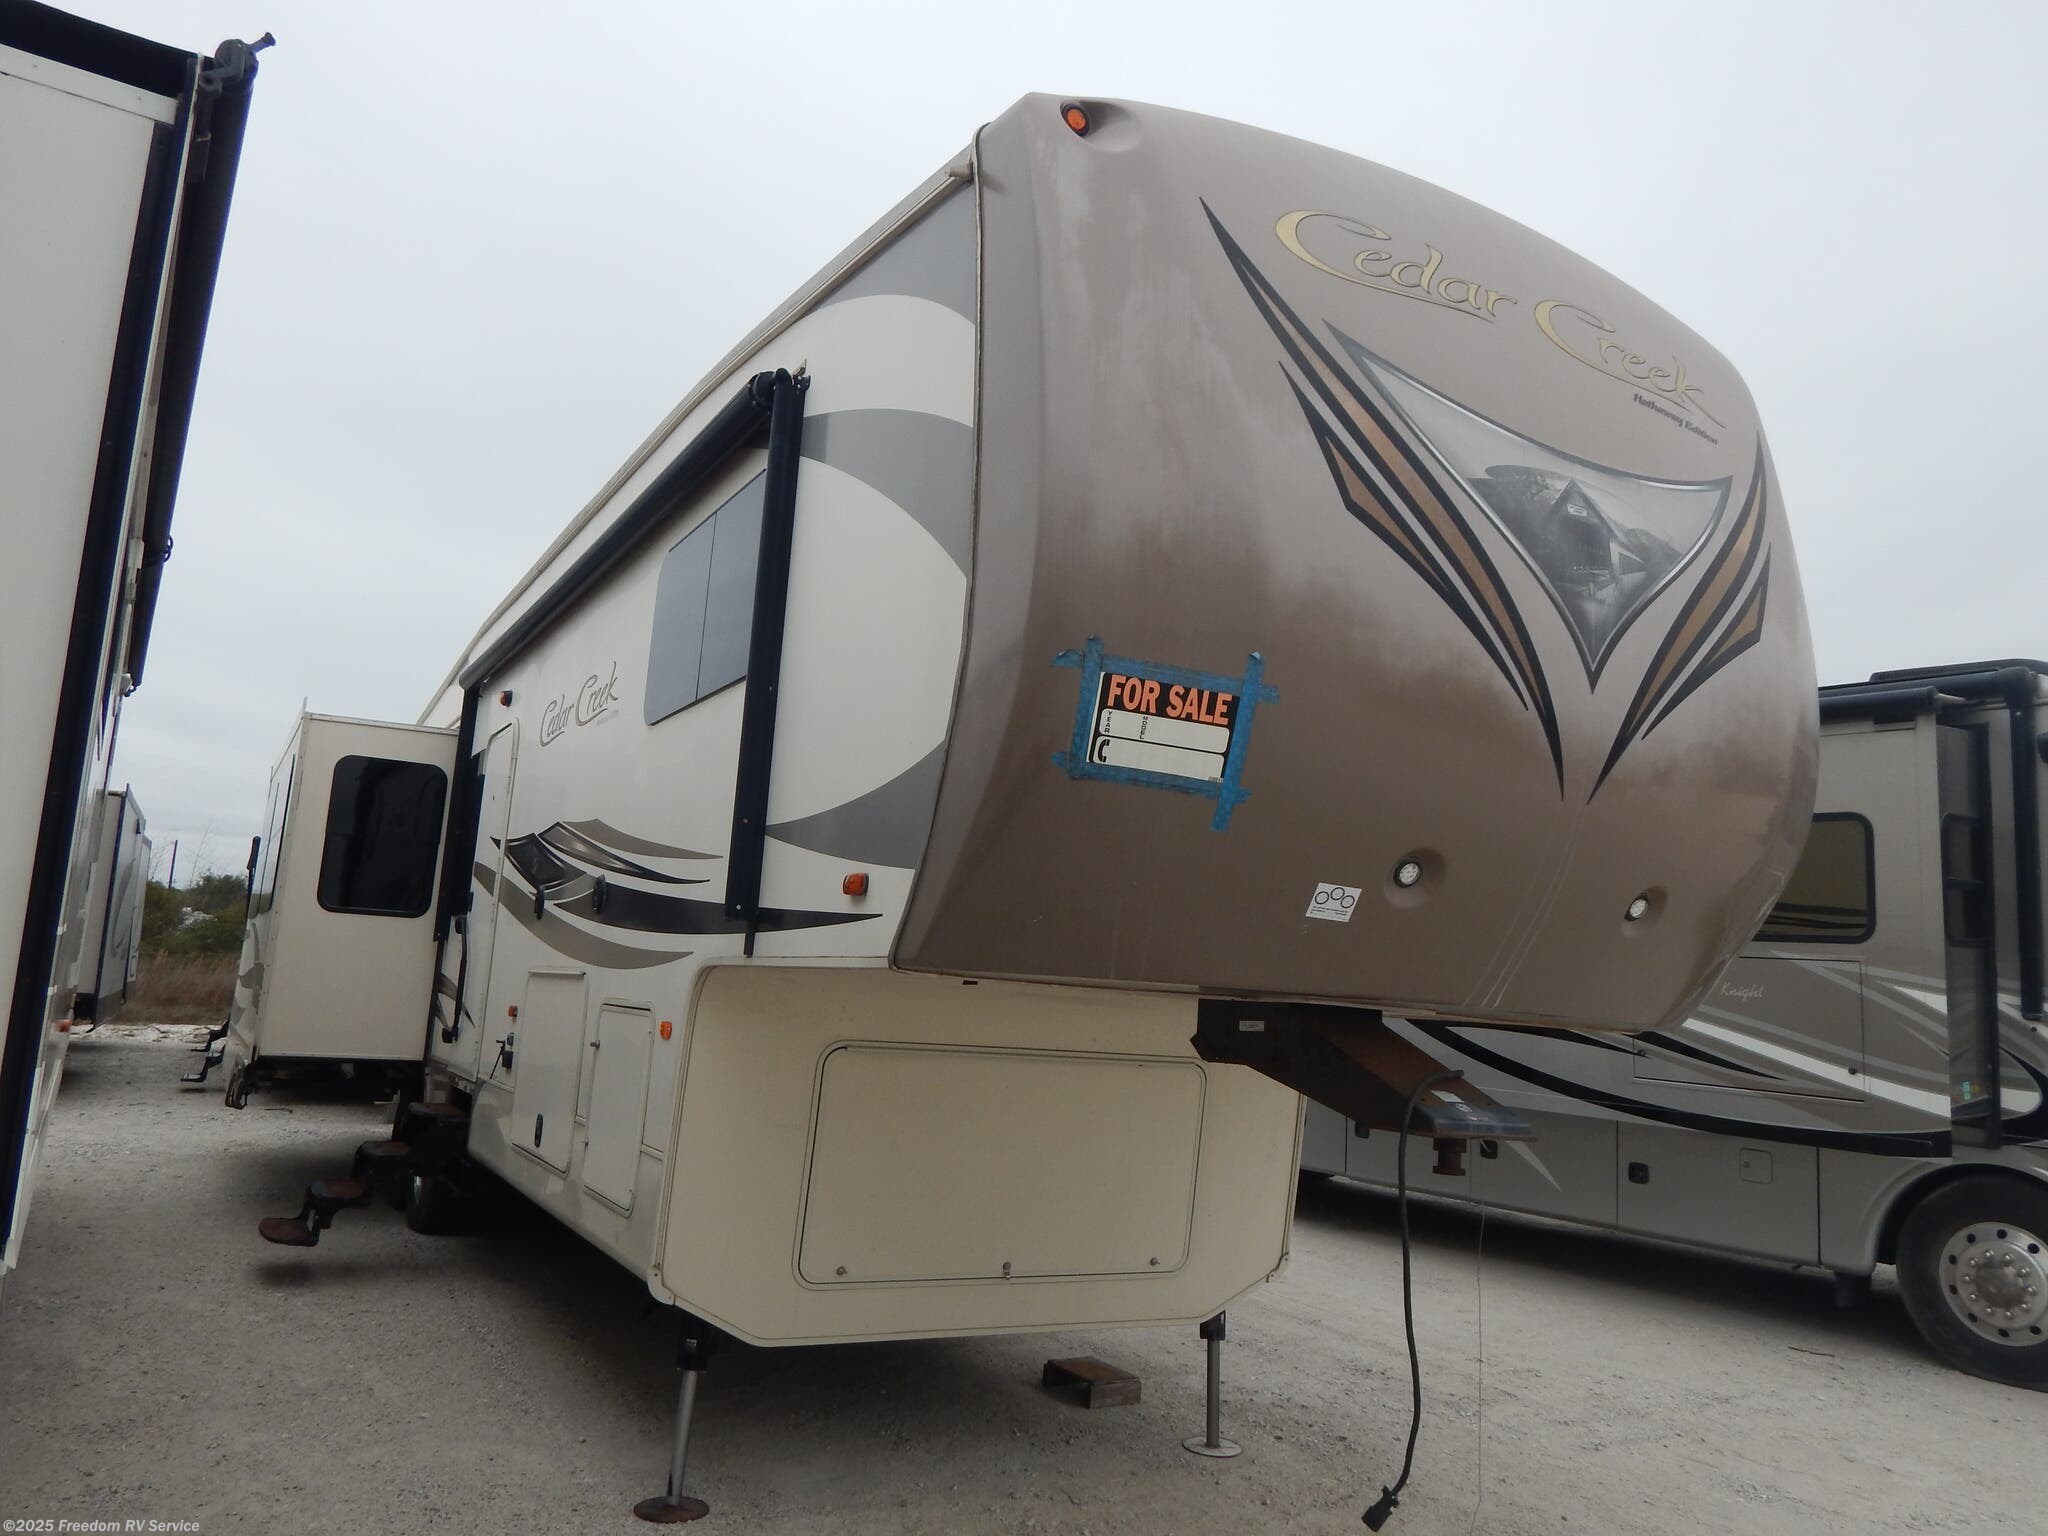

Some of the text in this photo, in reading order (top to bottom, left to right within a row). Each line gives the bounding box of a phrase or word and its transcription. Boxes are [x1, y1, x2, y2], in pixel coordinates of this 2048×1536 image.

[1275, 209, 1726, 429] Cedar Creek
[1633, 393, 1718, 446] Hathaway Edition
[540, 660, 619, 747] Cedar Creek
[1104, 710, 1113, 734] YEAR
[1107, 674, 1233, 726] FOR SALE
[1139, 715, 1149, 740] MODEL
[1719, 981, 1765, 1001] Knight
